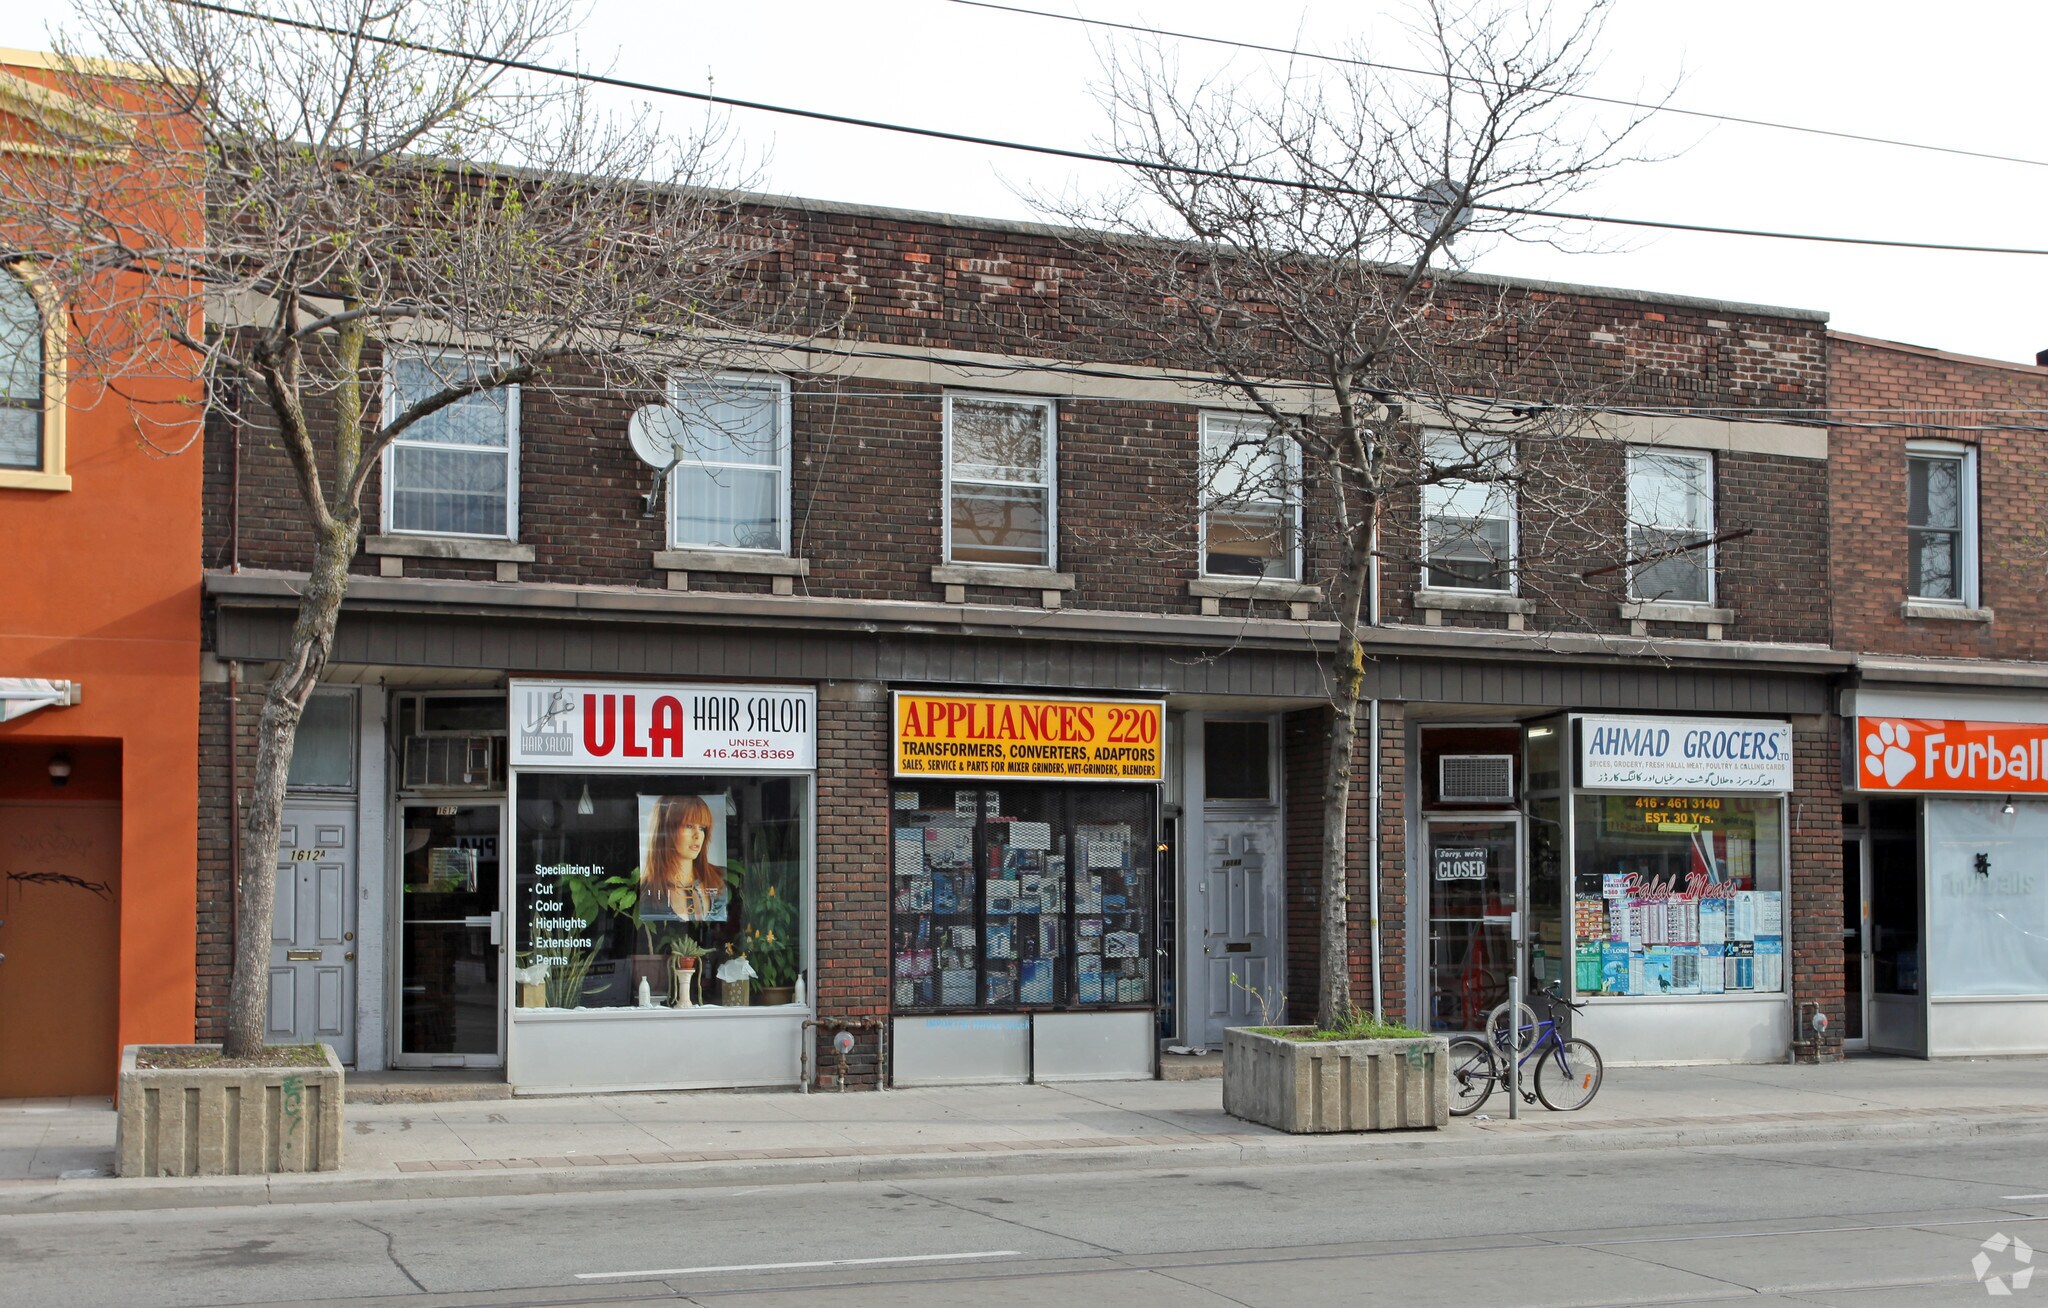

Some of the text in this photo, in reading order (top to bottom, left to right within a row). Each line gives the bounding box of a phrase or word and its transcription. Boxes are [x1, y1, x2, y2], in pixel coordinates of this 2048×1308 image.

[693, 696, 807, 734] HAIR SALON
[583, 693, 684, 758] ULA
[901, 701, 1157, 744] APPLIANCES 220
[522, 736, 572, 753] HAIR SALON
[728, 738, 770, 748] UNISEX
[1589, 726, 1790, 761] AHMAD GROCERS LTD
[703, 748, 795, 760] 416.463.8369
[902, 741, 1155, 762] TRANSFORMERS, CONVERTERS, ADAPTORS
[1924, 732, 2048, 781] Furball
[902, 759, 1155, 776] SALES, SERVICE & PARTS FOR MIXER GRINDERS, WET-GRINDERS, BLENDERS
[1589, 760, 1613, 769] SPICES,
[1614, 761, 1645, 769] GROCERY,
[1646, 761, 1664, 769] FRESH
[1687, 762, 1705, 771] MEAT,
[1761, 778, 1775, 787] احمد
[1635, 797, 1657, 808] 416
[1667, 798, 1688, 809] 461
[1692, 798, 1720, 809] 3140
[438, 806, 457, 815] 1612
[1645, 812, 1670, 823] EST.
[1673, 813, 1688, 823] 30
[1691, 813, 1714, 824] Yrs.
[291, 850, 326, 861] 1612A
[1440, 850, 1462, 859] Sorry,
[535, 864, 605, 877] Specializing In:
[1438, 860, 1486, 878] CLOSED
[535, 883, 553, 895] Cut
[1622, 871, 1737, 900] Halal Meats
[535, 900, 563, 912] Color
[535, 917, 587, 931] Highlights
[536, 937, 592, 948] Extensions
[536, 954, 568, 966] Perms
